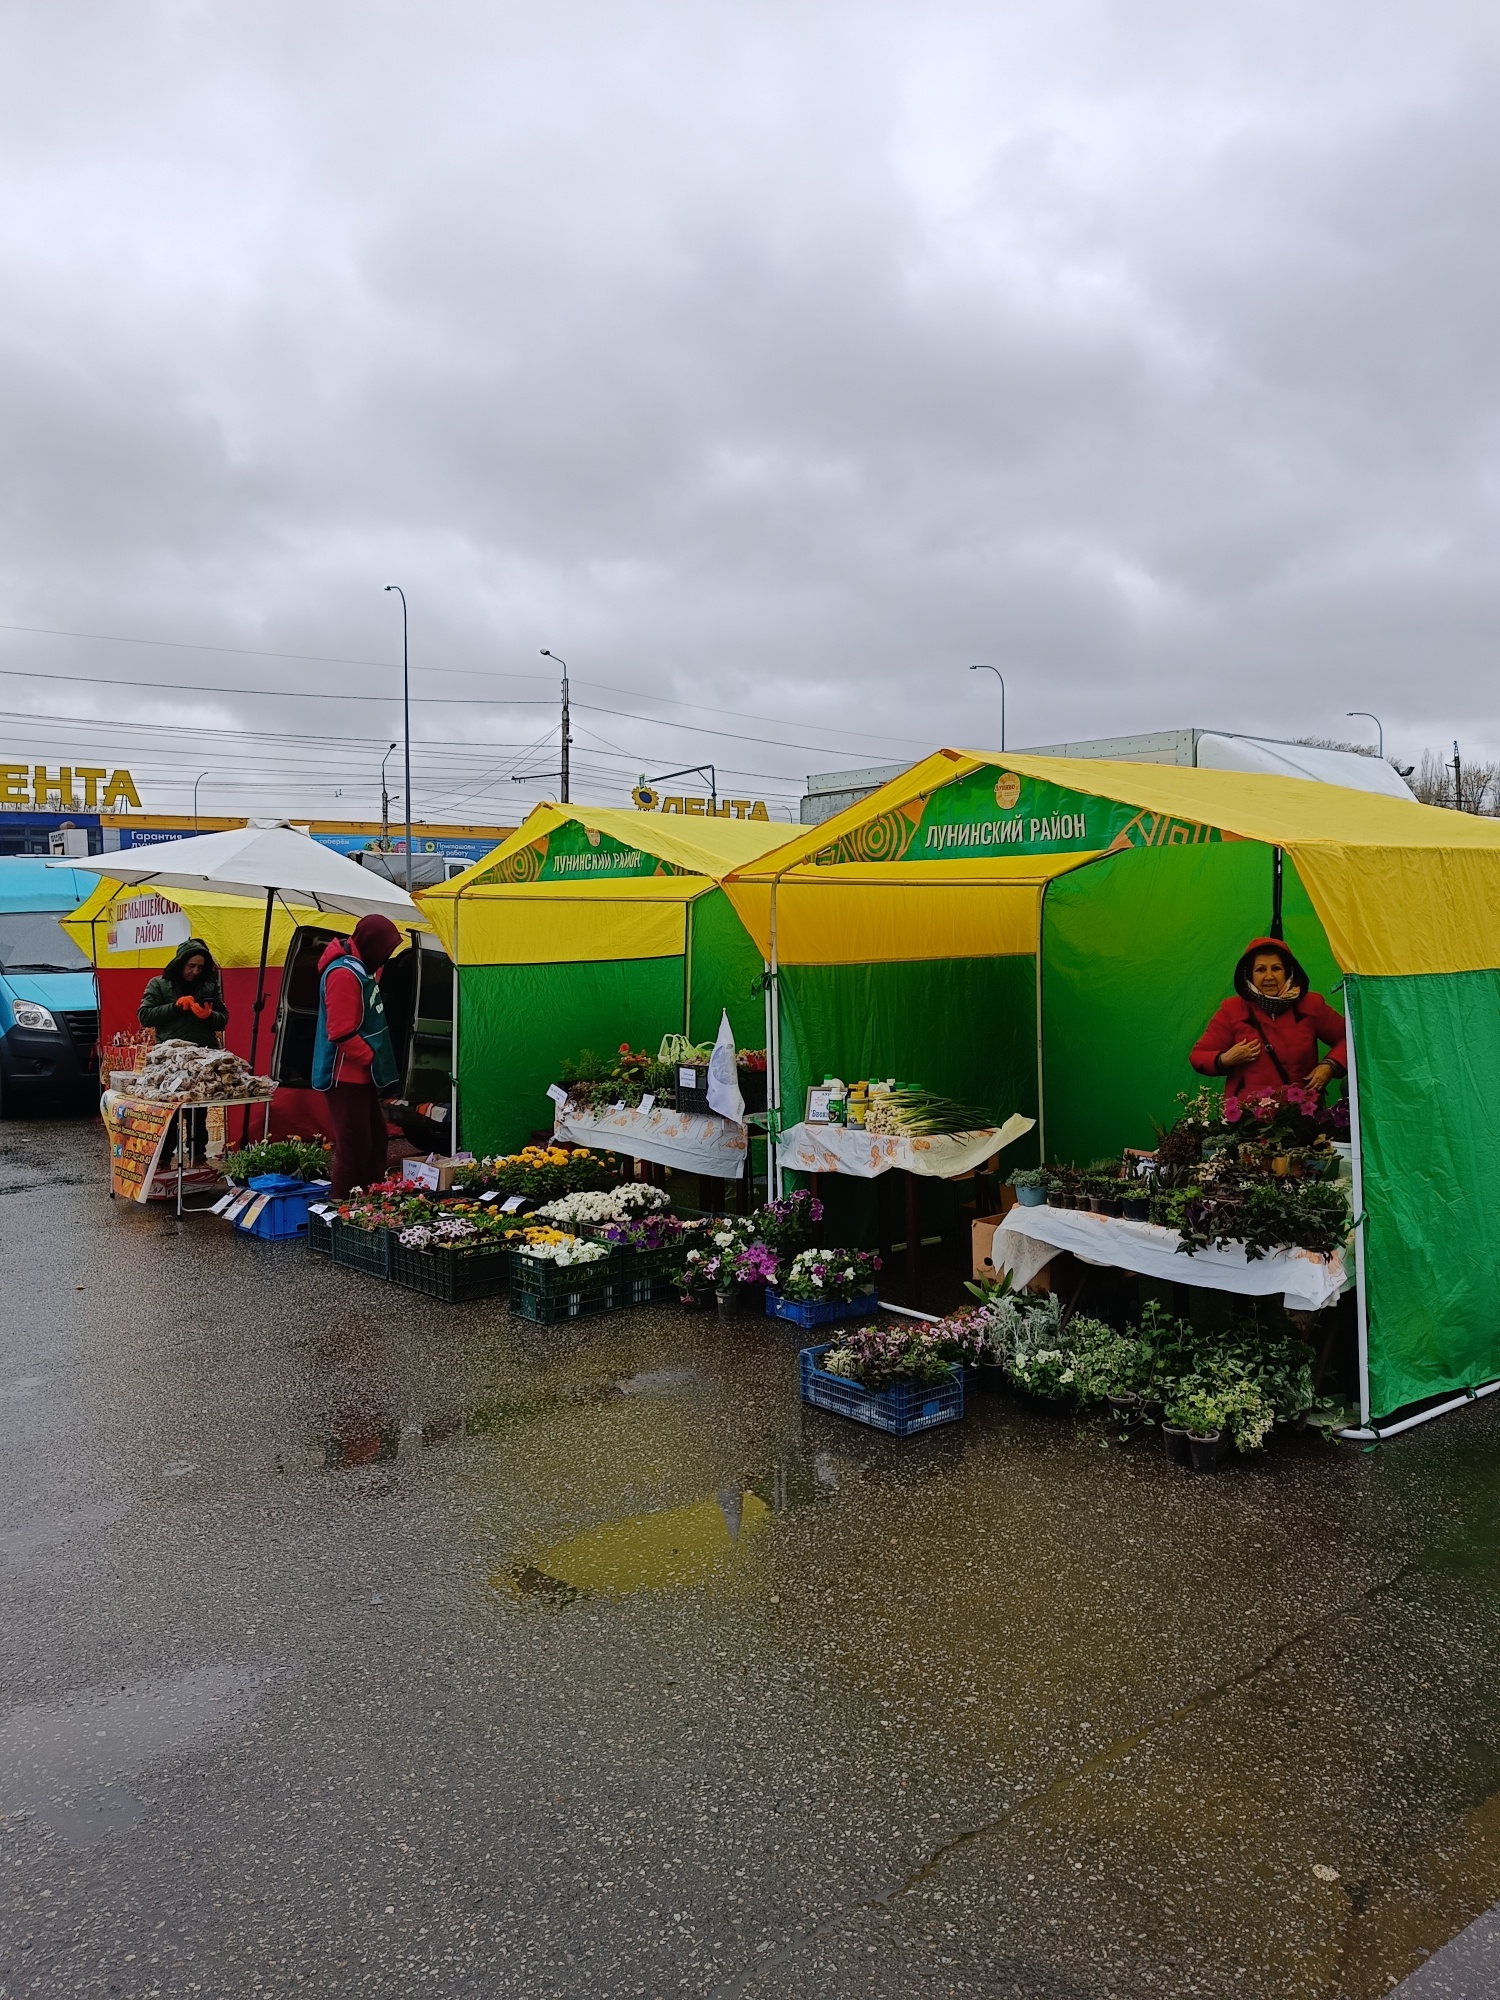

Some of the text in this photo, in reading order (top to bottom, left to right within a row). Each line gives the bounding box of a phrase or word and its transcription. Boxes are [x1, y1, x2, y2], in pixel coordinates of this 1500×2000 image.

[661, 797, 769, 821] ЛЕНТА
[131, 831, 182, 842] Гарантия
[924, 810, 1086, 851] ЛУНИНСКИЙ РАЙОН
[436, 842, 476, 850] Приглашаем
[553, 848, 641, 874] ЛУНИНСКИЙ РАЙОН
[116, 892, 182, 922] ШЕМЫШЕЙСКИ
[135, 919, 164, 944] РАЙОН
